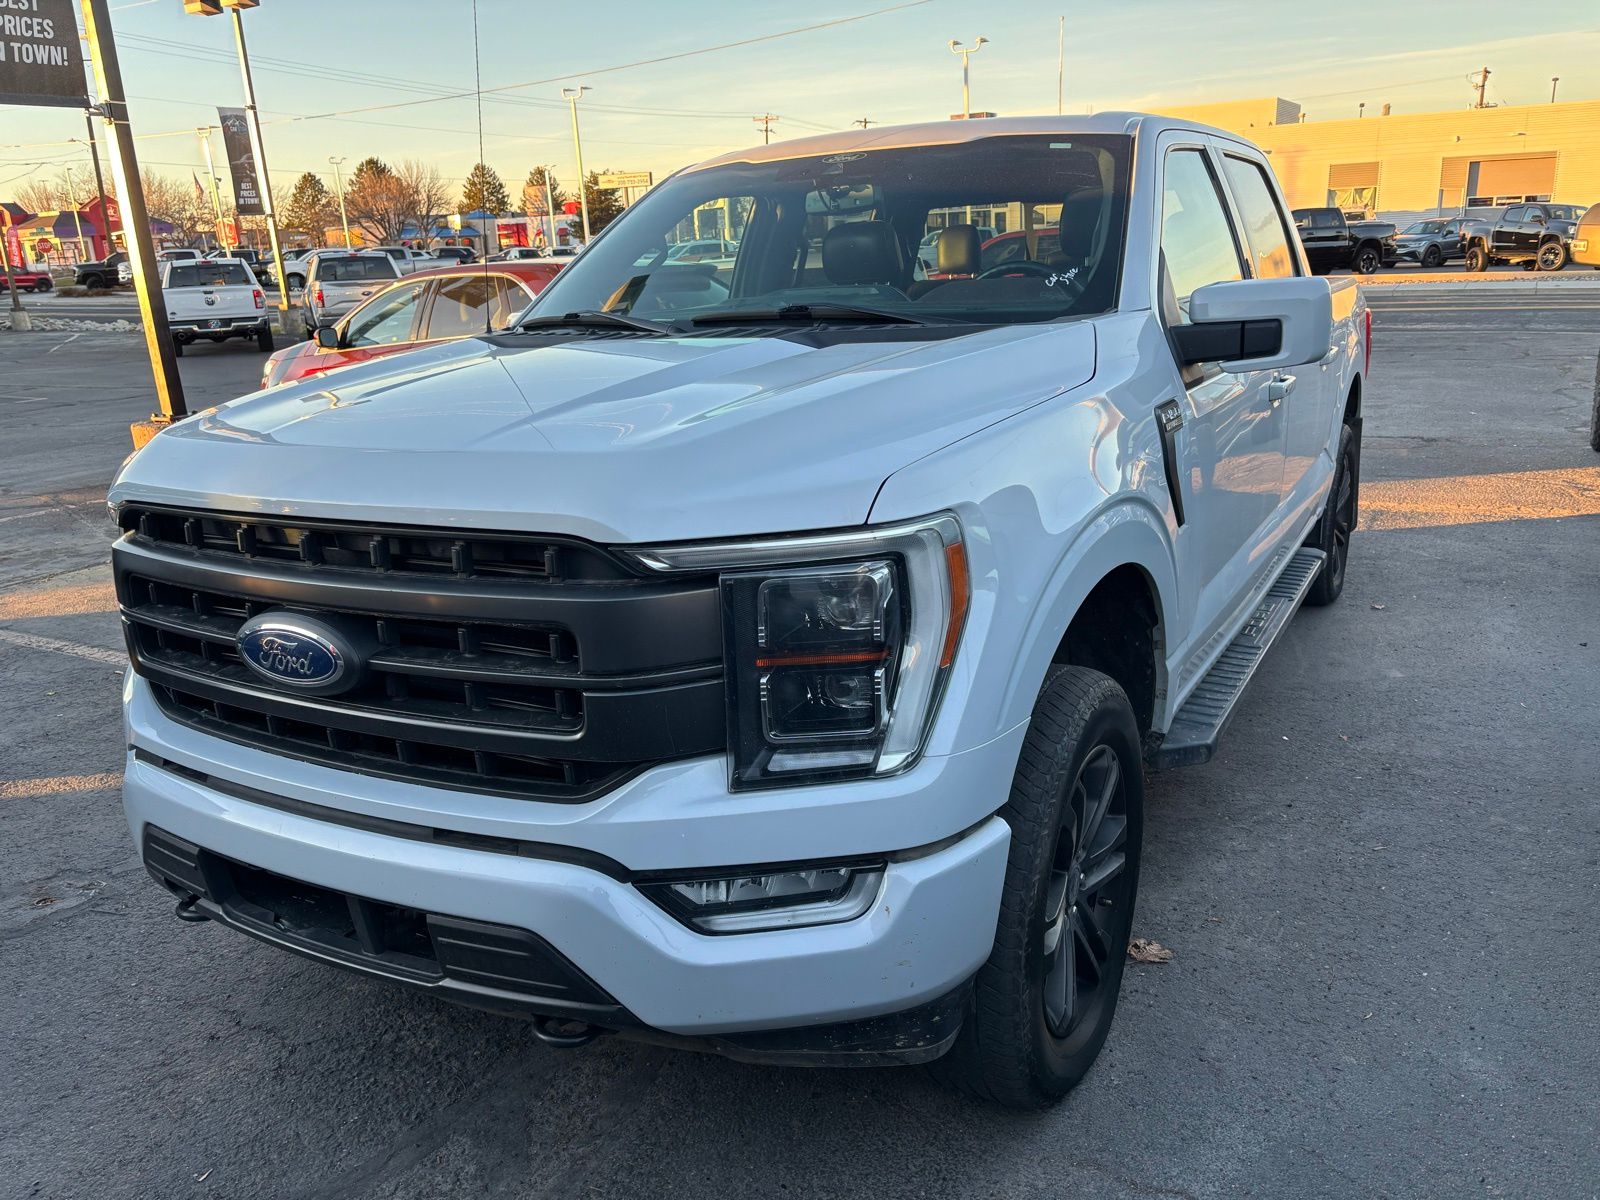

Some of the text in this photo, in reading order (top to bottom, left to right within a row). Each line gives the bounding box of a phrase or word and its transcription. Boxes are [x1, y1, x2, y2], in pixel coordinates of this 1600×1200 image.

[0, 0, 38, 11] ST
[10, 42, 68, 66] TOWN!
[259, 636, 314, 675] Ford
